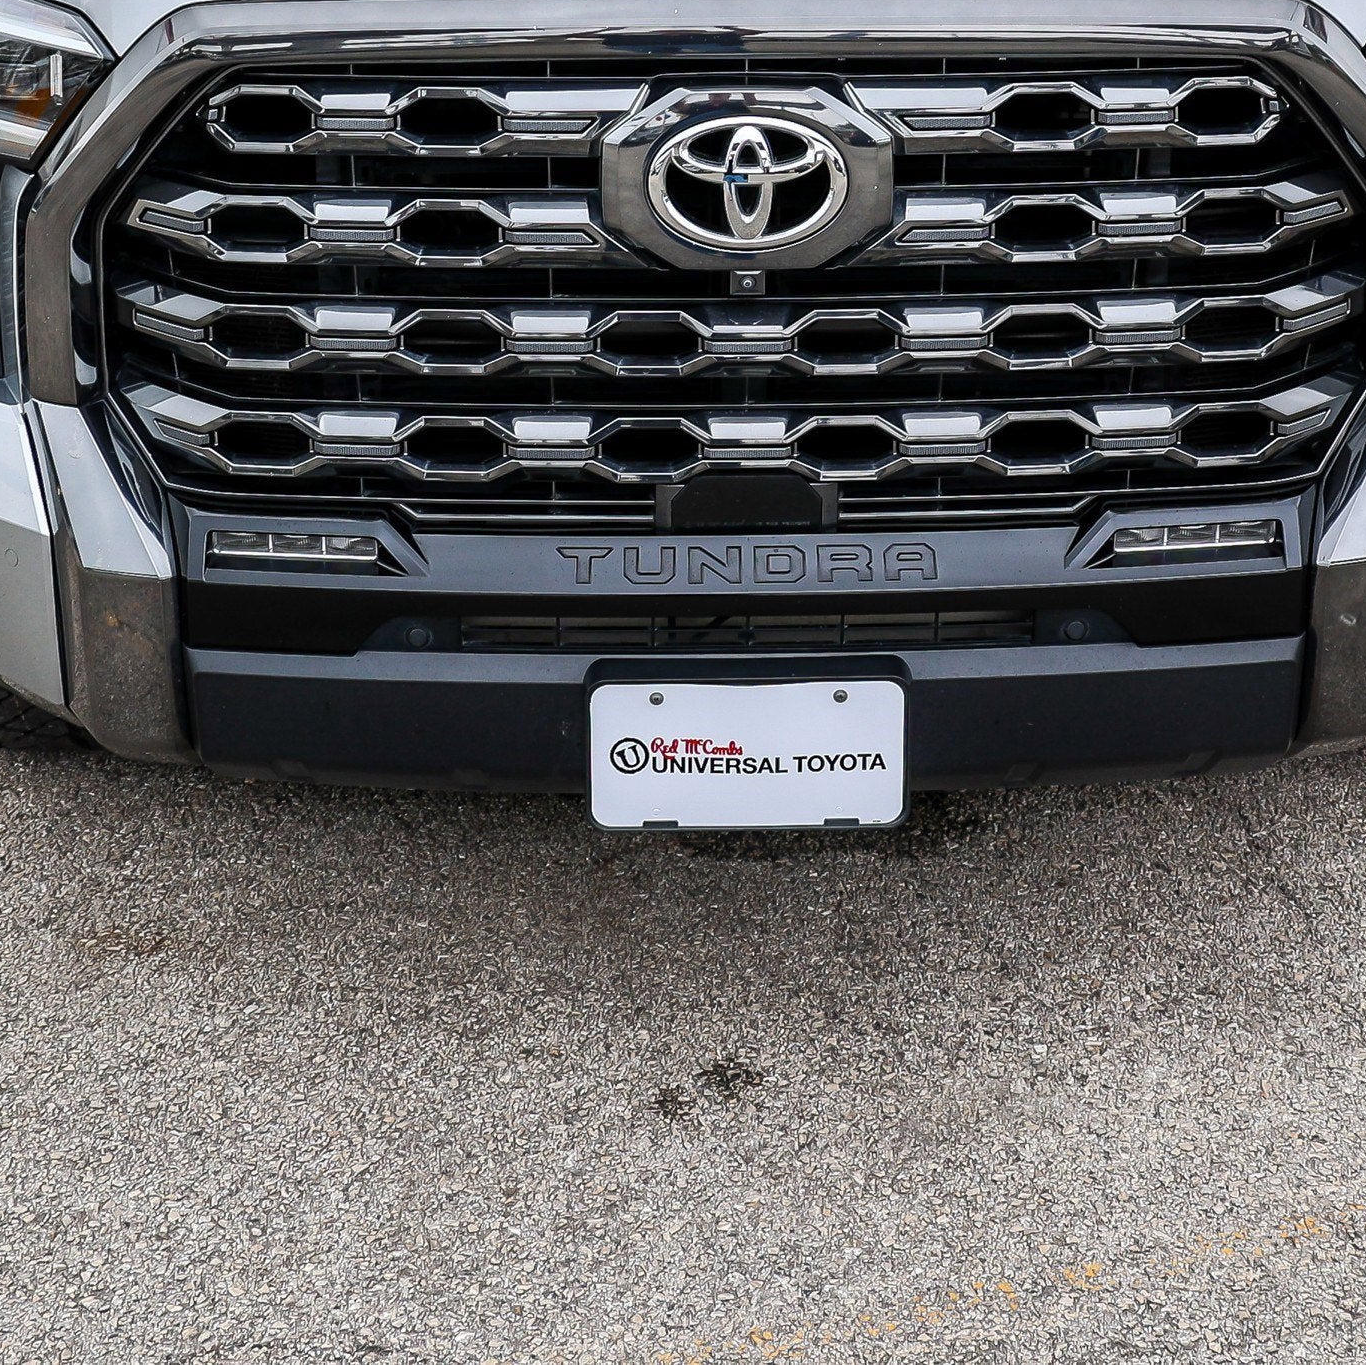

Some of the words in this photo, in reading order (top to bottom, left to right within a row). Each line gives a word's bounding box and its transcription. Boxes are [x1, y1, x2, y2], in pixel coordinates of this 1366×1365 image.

[555, 543, 938, 585] TUNDRA
[650, 737, 679, 757] Red
[680, 737, 743, 755] McCombs
[652, 756, 788, 774] UNIVERSAL
[793, 753, 886, 772] TOYOTA
